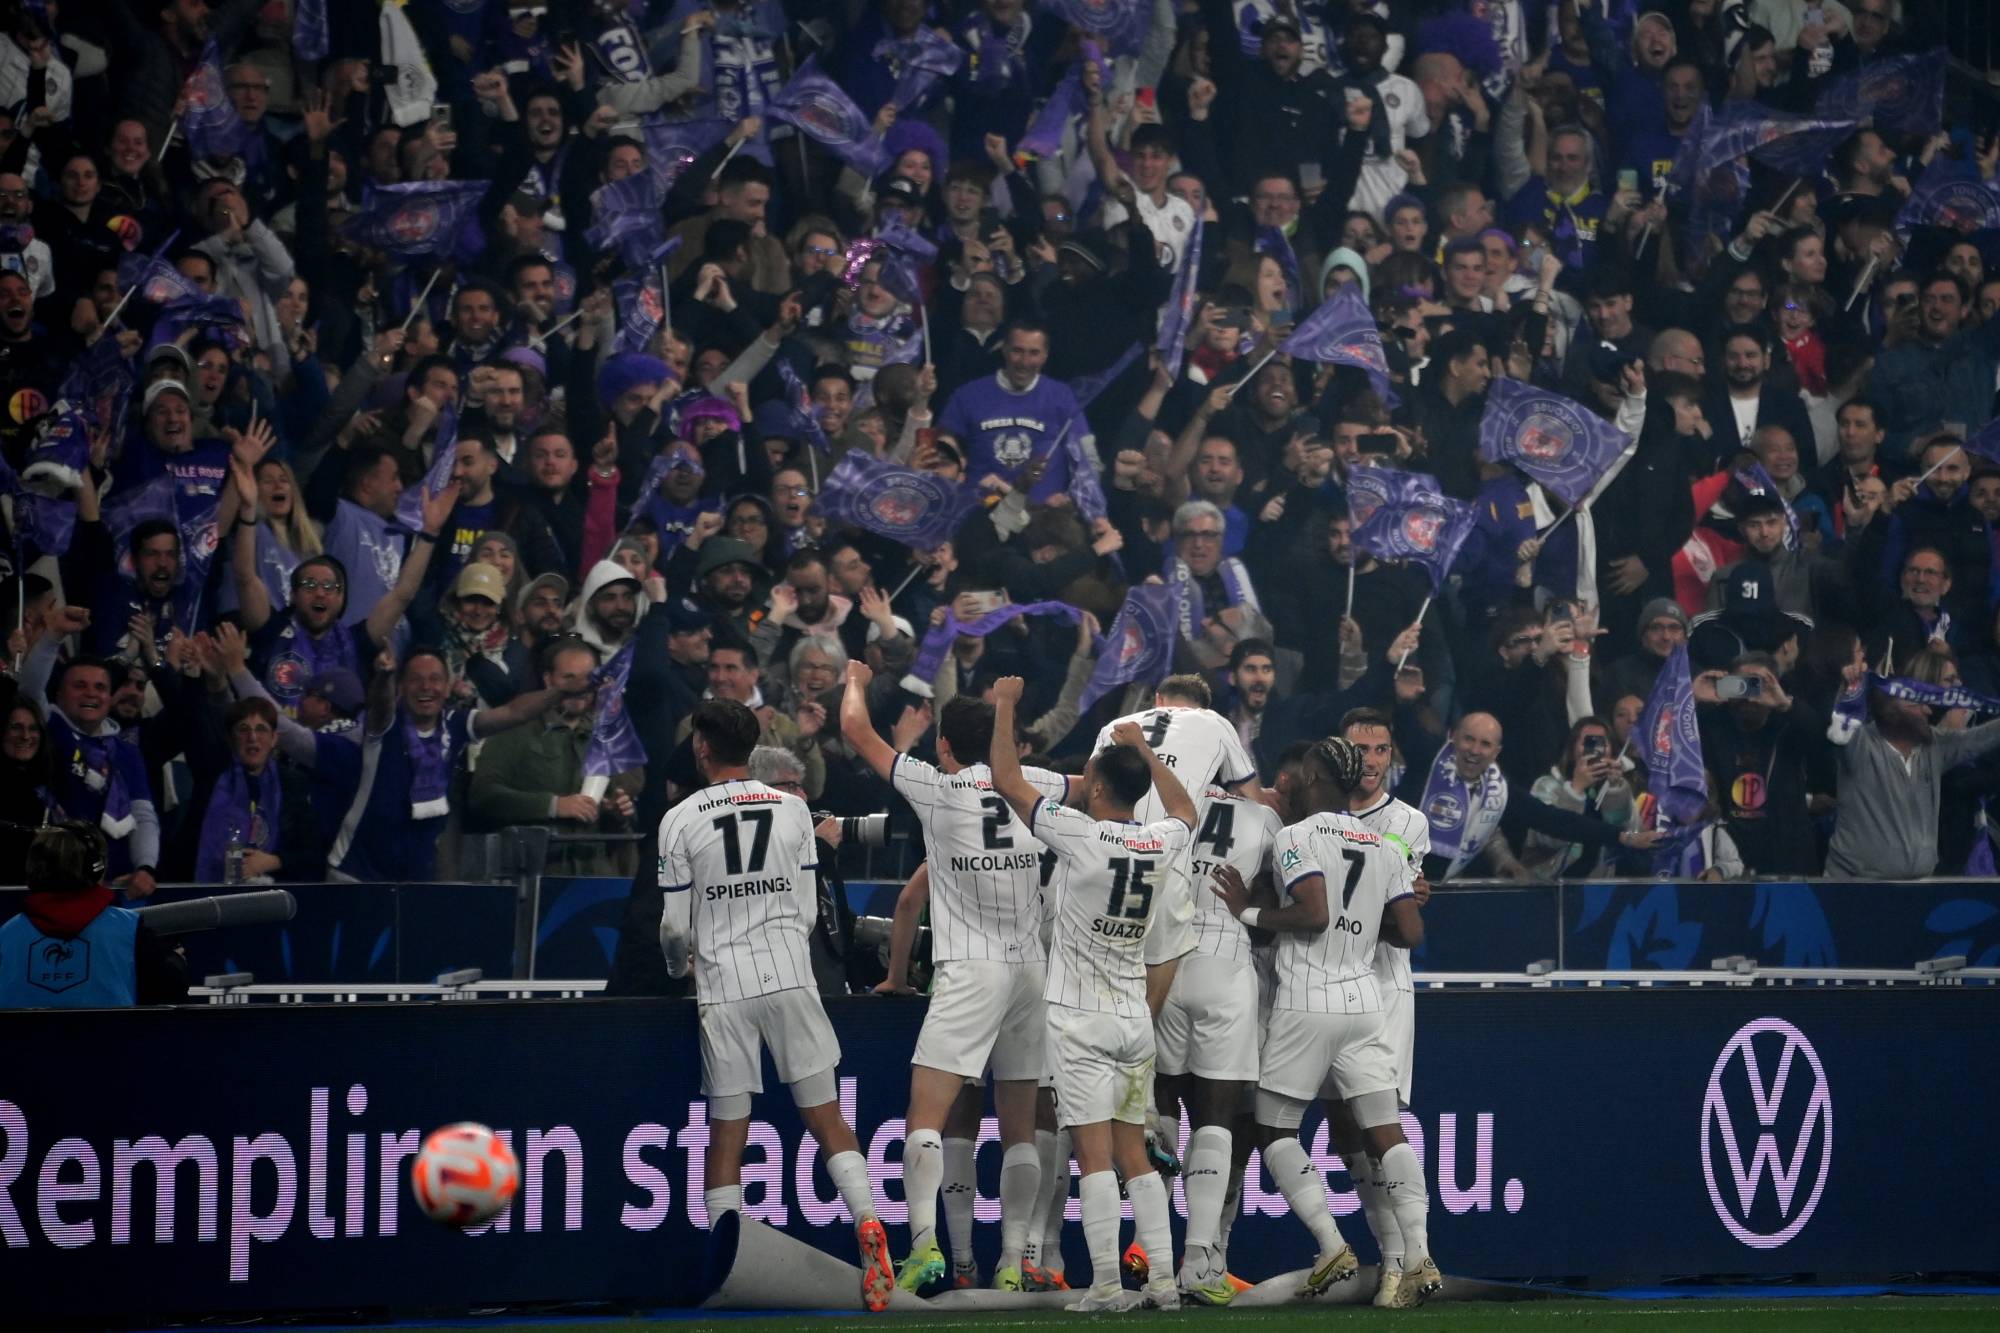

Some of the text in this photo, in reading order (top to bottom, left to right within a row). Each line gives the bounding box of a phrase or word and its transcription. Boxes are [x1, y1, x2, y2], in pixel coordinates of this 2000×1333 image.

[1741, 580, 1759, 600] 31
[712, 808, 774, 876] 17
[980, 796, 1014, 850] 2
[1198, 801, 1235, 859] 4
[705, 877, 792, 901] SPIERINGS
[951, 852, 1038, 872] NICOLAISEN
[1107, 856, 1155, 919] 15
[1341, 847, 1366, 912] 7
[1091, 918, 1146, 939] SUAZO
